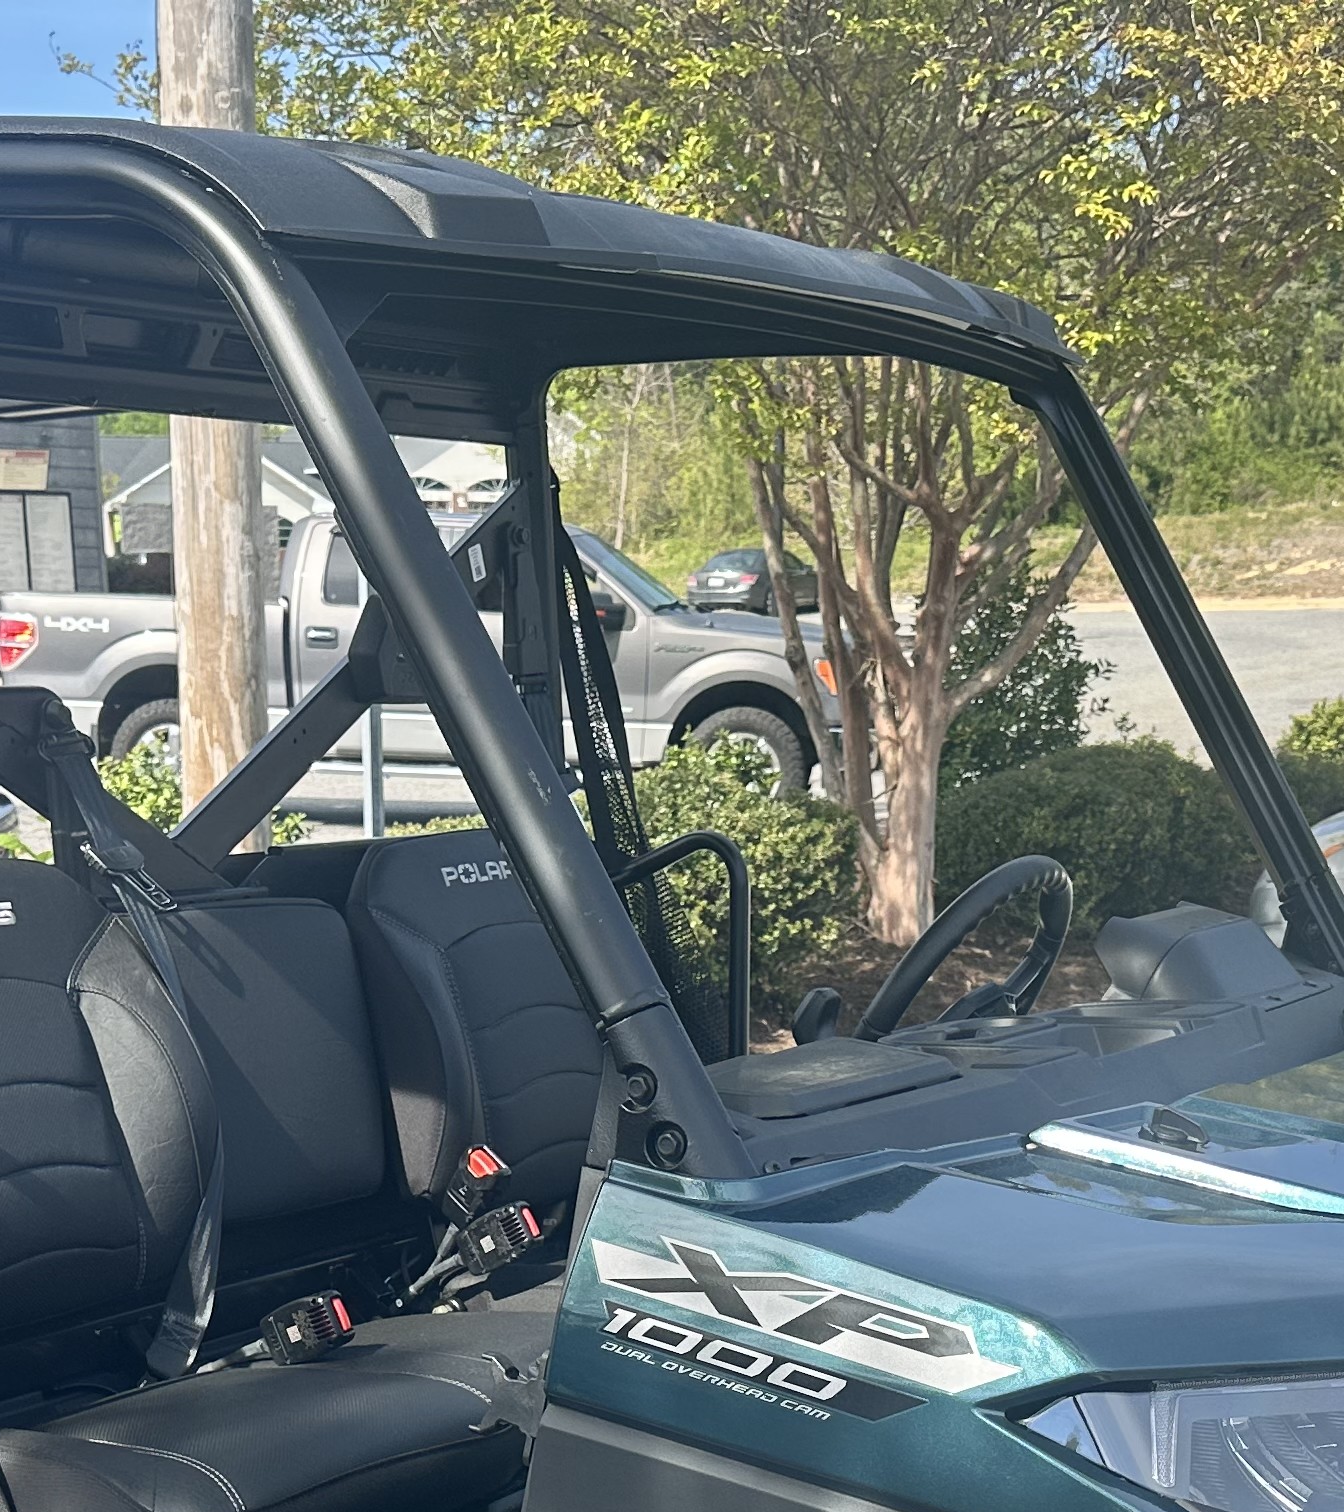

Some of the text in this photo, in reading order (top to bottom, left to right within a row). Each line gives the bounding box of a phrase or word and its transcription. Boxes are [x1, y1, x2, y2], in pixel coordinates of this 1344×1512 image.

[440, 861, 512, 887] POLAR
[602, 1236, 980, 1358] XP
[600, 1341, 832, 1421] DUAL OVERHEAD CAM
[602, 1307, 848, 1401] 1000
